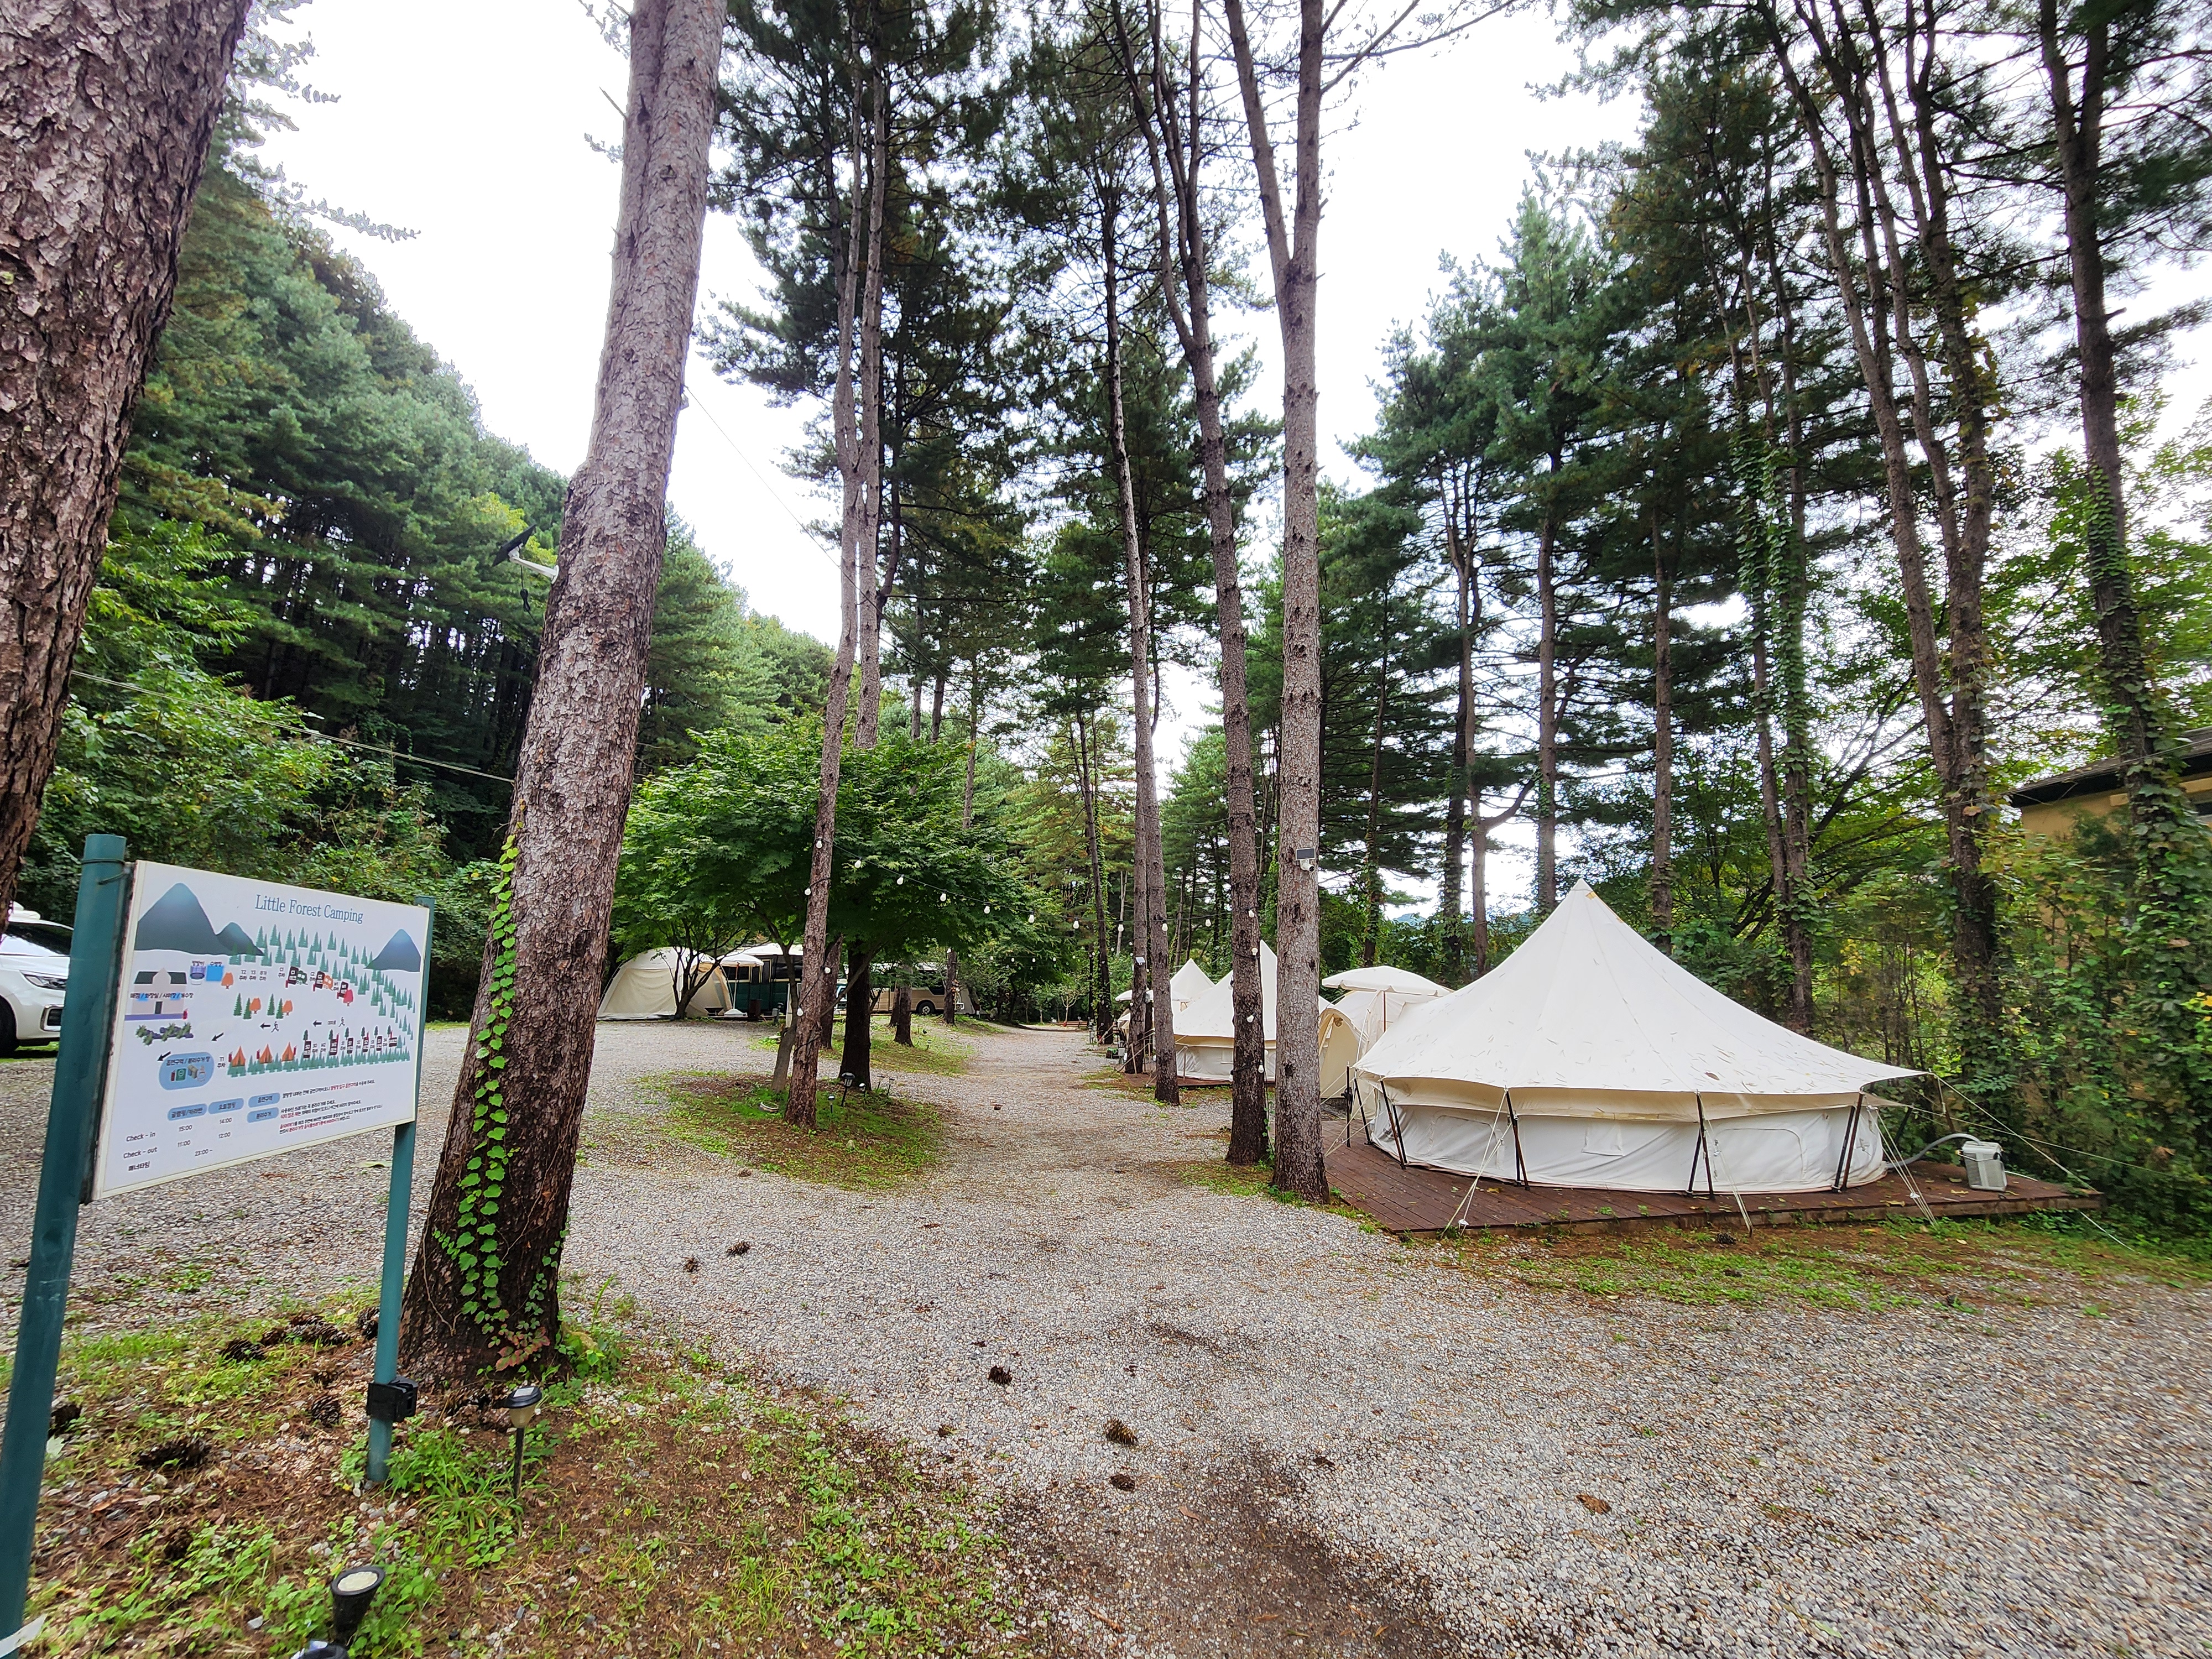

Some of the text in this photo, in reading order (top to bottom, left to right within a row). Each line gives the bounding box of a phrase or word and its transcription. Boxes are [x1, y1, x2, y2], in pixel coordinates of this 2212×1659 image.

[255, 894, 363, 924] Little Forest Camping
[258, 1095, 273, 1103] 흡연구역
[126, 1133, 144, 1141] Check
[123, 1150, 141, 1159] Check
[128, 1161, 150, 1172] 매너타임
